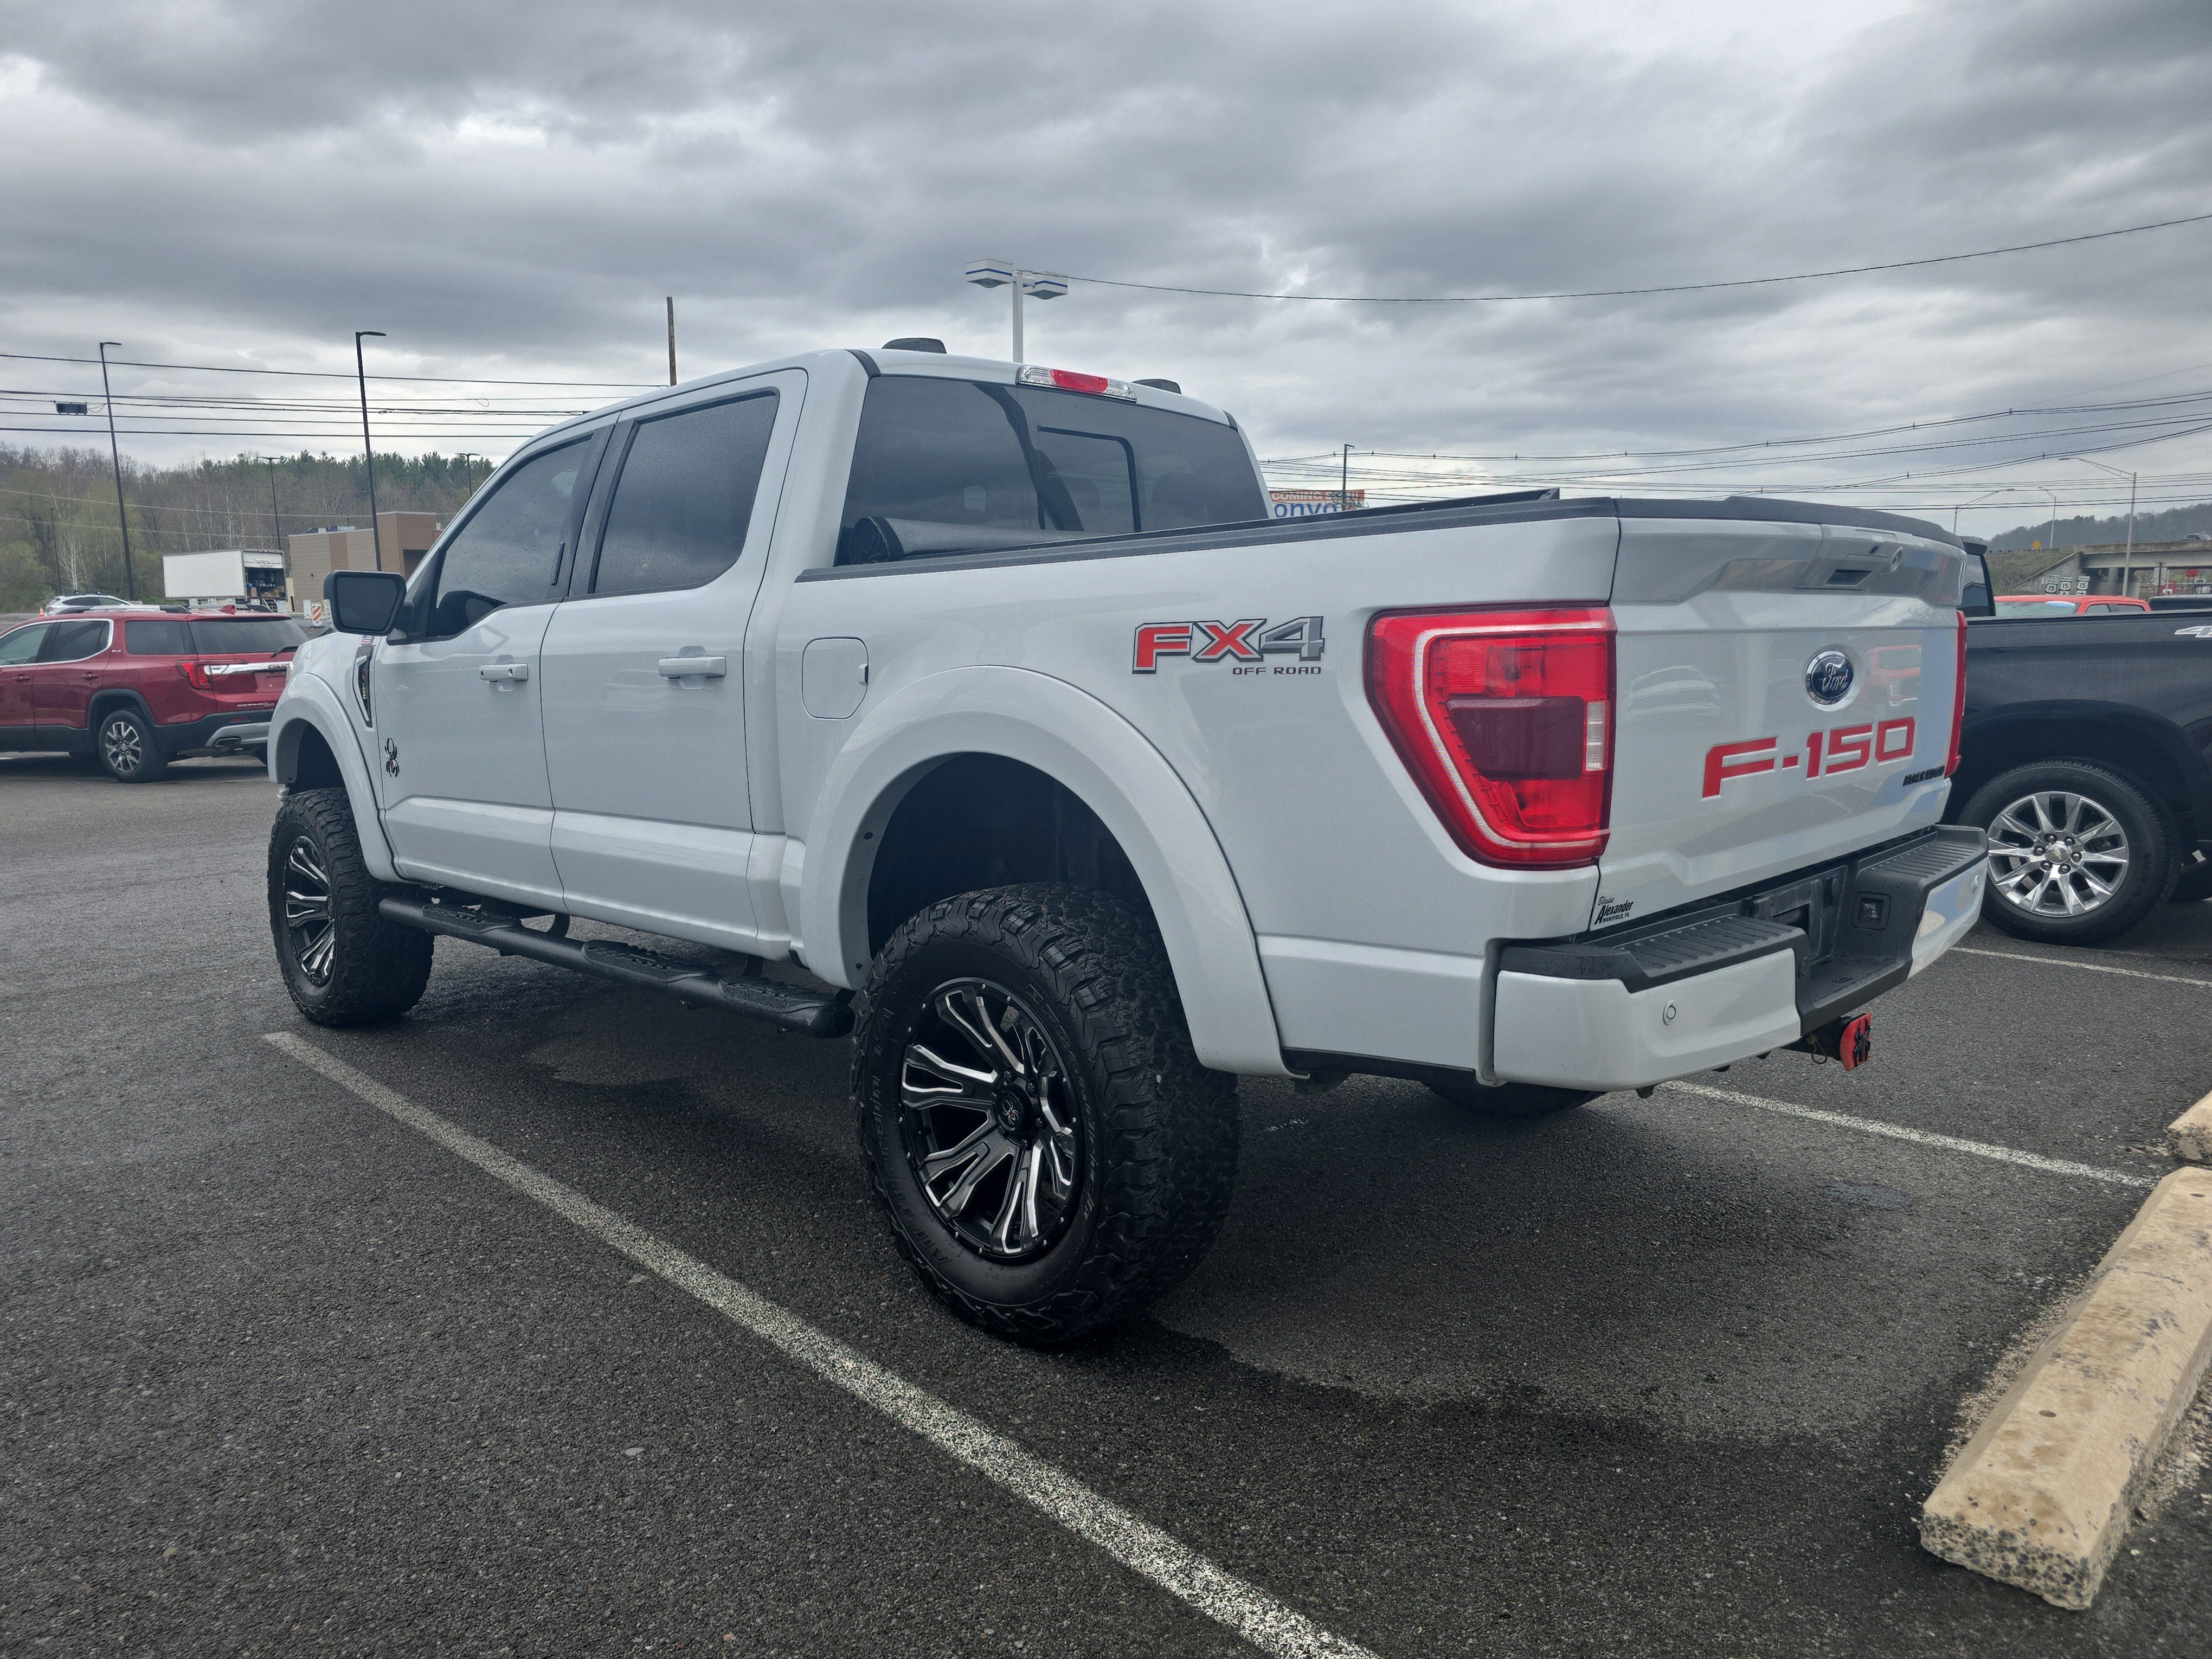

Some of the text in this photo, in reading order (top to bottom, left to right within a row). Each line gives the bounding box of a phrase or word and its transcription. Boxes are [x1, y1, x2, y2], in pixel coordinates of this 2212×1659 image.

[1271, 491, 1323, 500] COMING
[1132, 615, 1325, 674] FX4
[1232, 666, 1322, 675] OFF ROAD
[1701, 717, 1915, 801] F-150
[1593, 900, 1635, 925] Alexander
